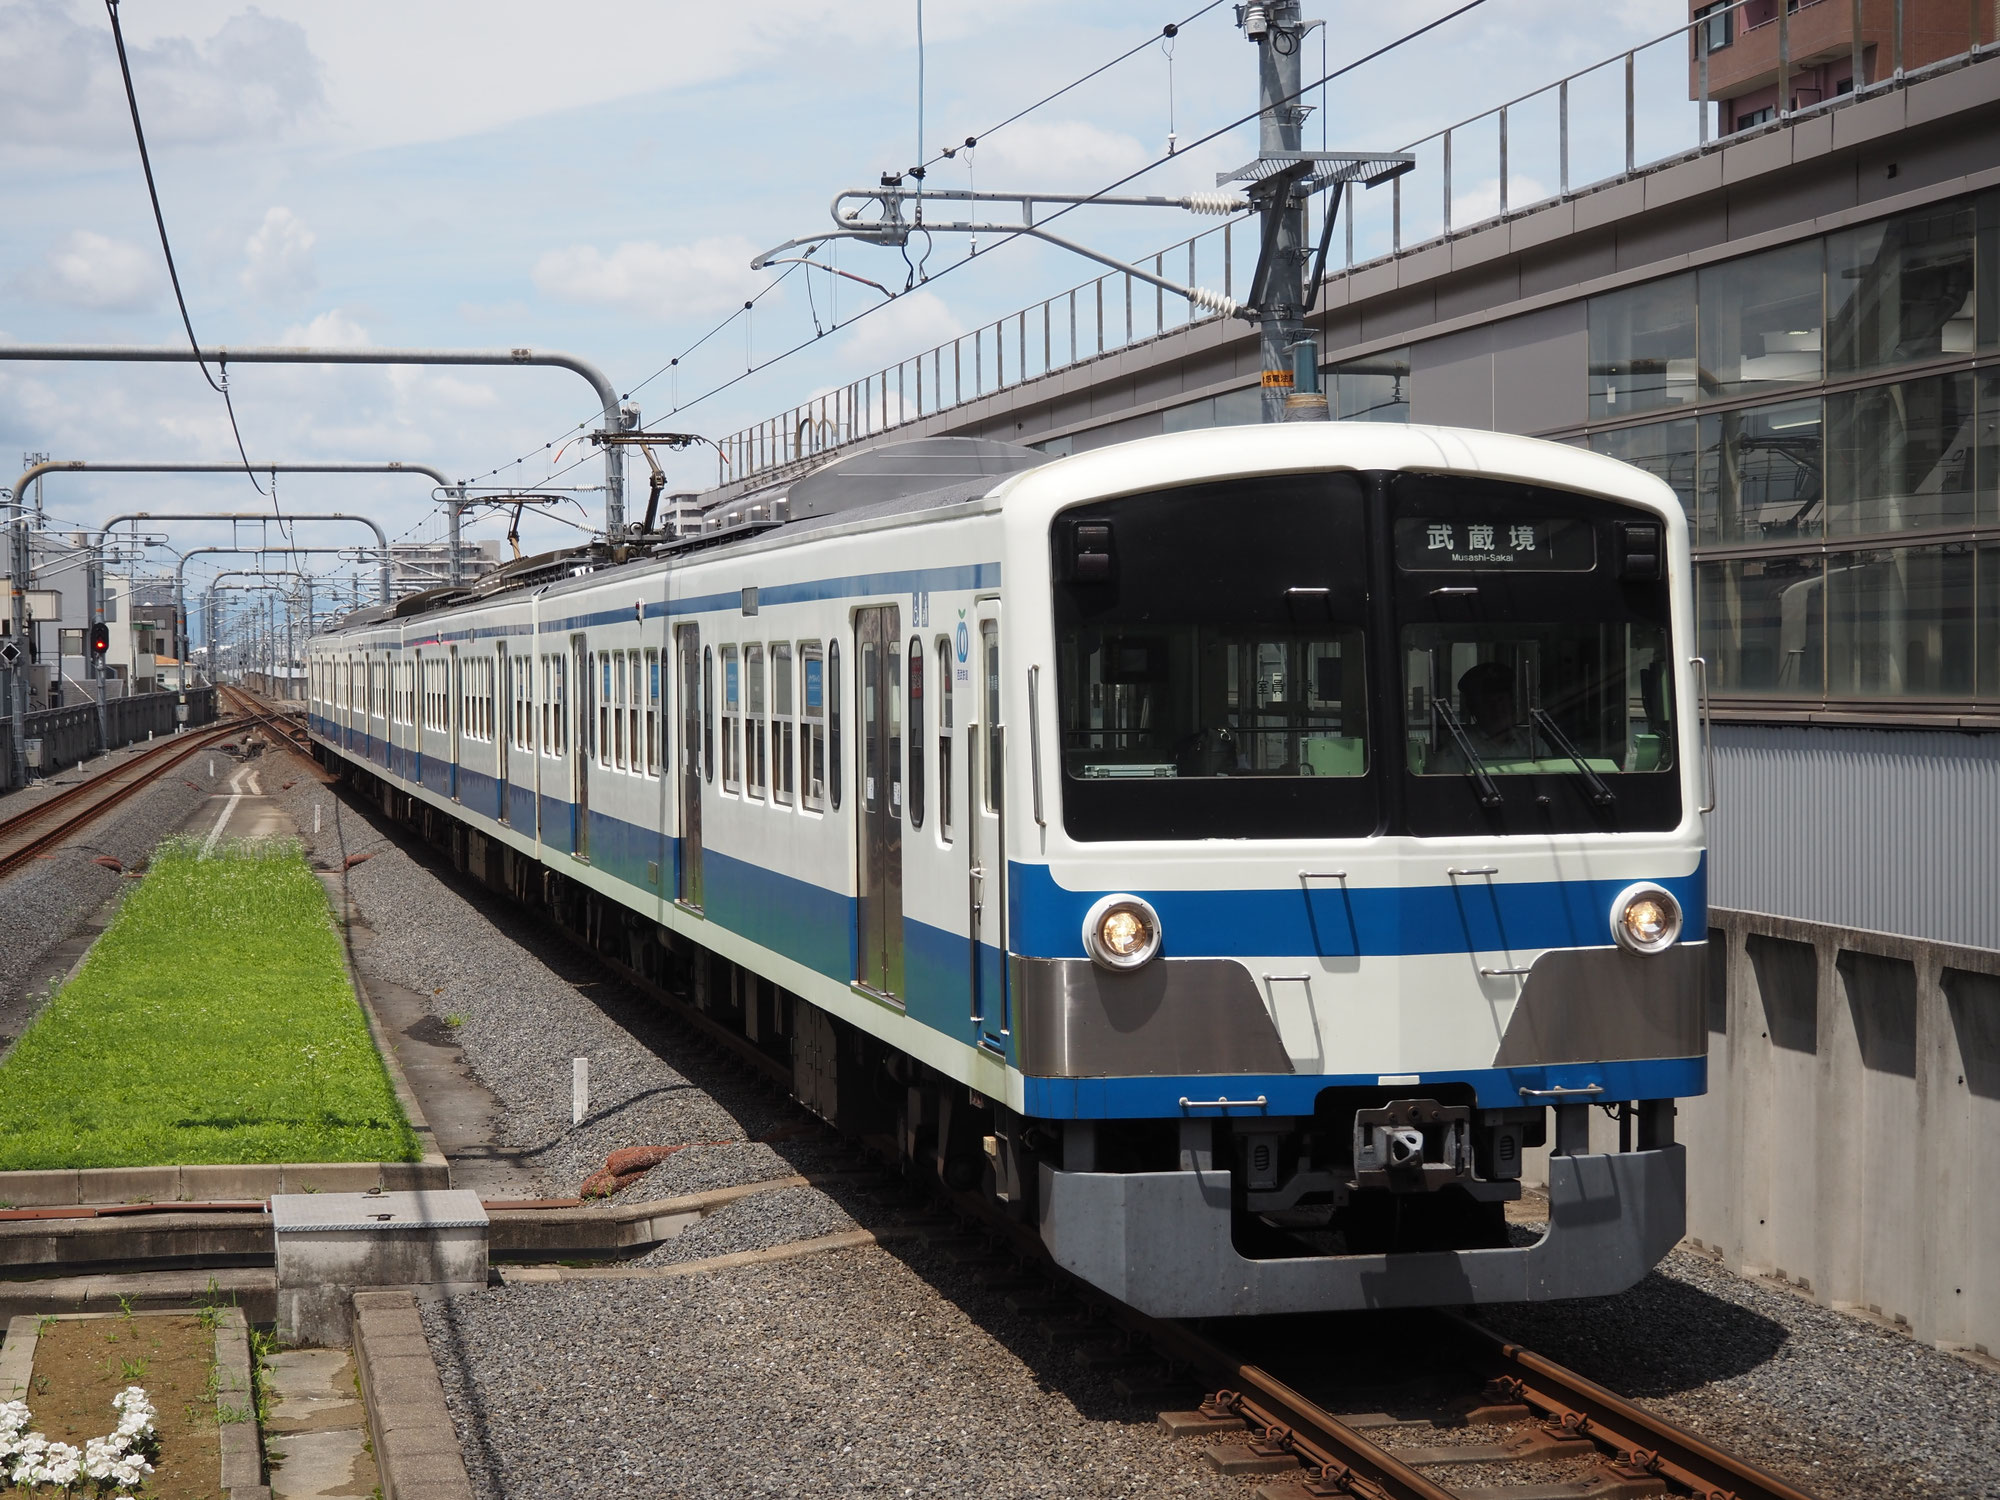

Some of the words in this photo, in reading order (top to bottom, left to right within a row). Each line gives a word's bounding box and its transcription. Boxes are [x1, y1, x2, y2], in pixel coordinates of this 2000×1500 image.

[1426, 524, 1536, 551] 武蔵境
[1451, 553, 1514, 562] Musashi-Sakai
